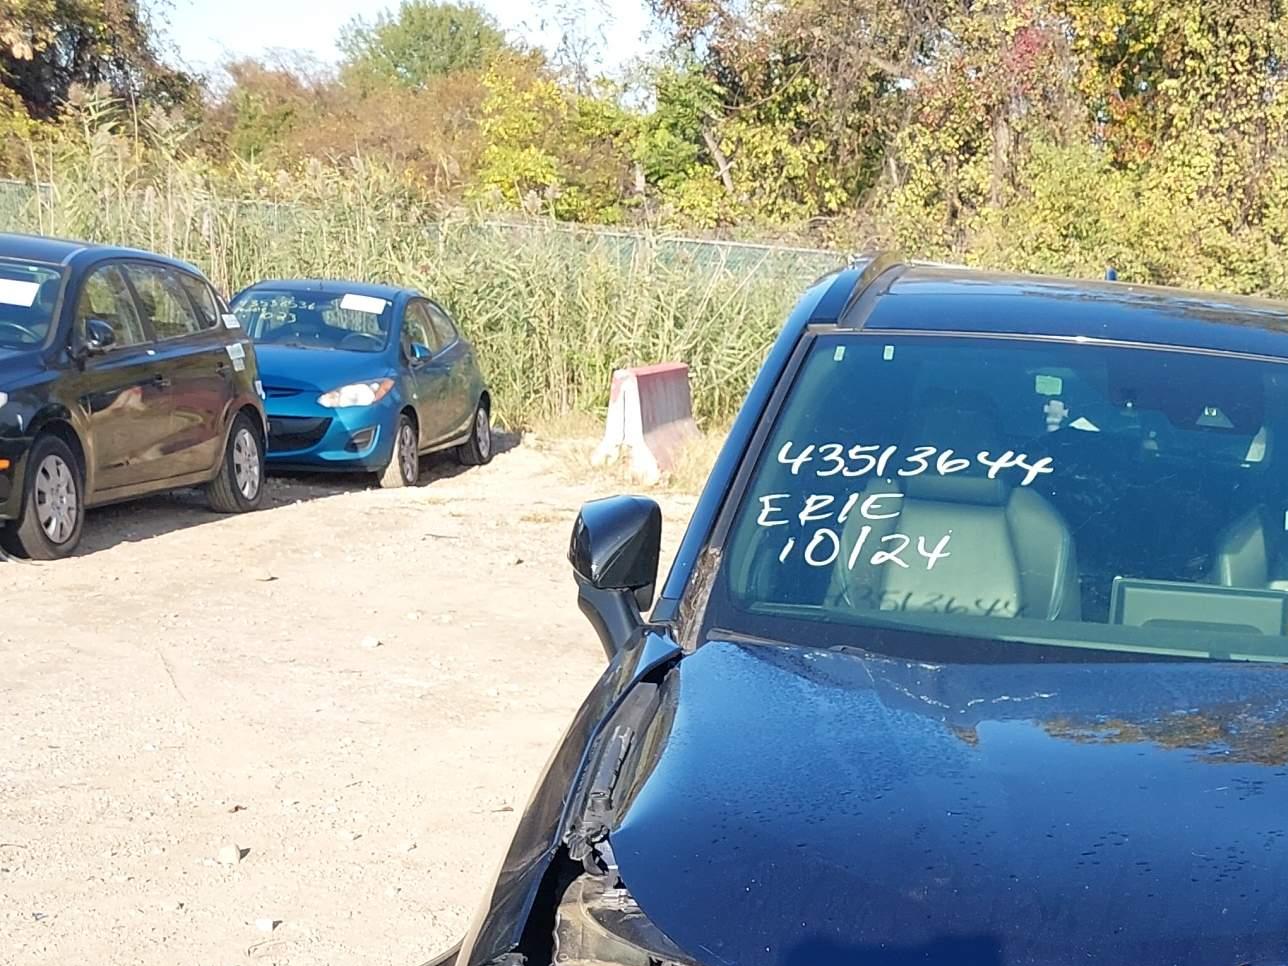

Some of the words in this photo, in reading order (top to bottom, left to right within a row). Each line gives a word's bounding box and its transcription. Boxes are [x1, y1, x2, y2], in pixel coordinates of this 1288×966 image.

[777, 441, 1054, 486] 43513644
[757, 492, 904, 527] ERIE
[779, 525, 954, 571] 10/24
